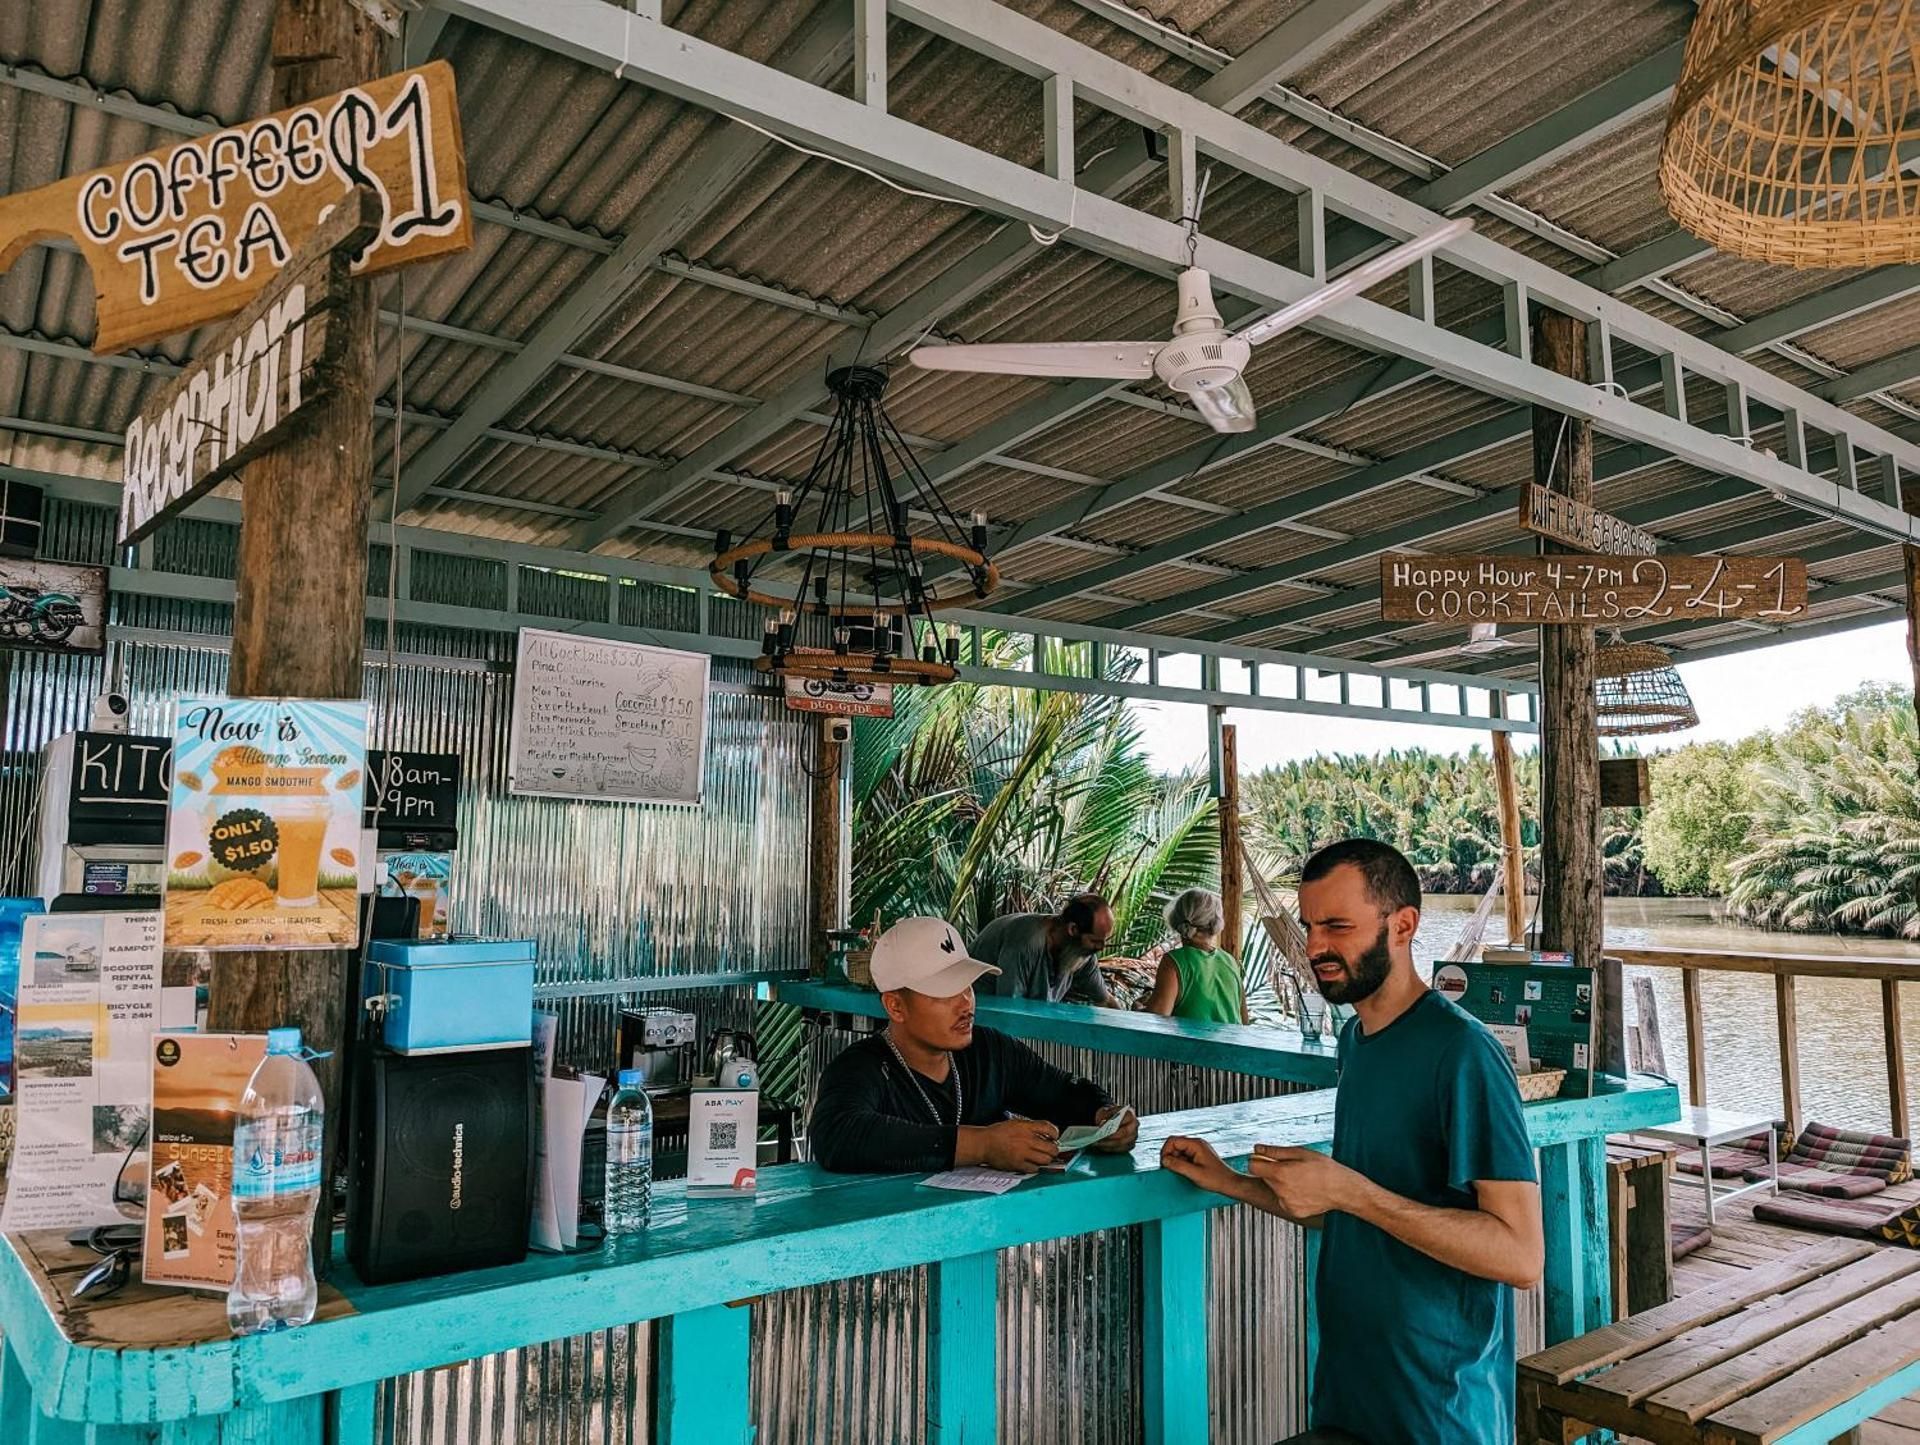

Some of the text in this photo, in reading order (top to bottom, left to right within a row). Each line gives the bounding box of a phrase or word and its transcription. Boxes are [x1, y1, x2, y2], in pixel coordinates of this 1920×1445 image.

[80, 75, 461, 266] COFFEE $1
[121, 203, 290, 304] TEA
[1393, 563, 1470, 587] Happy
[1479, 563, 1536, 587] Hour
[1624, 559, 1803, 618] 2-4-1
[1416, 591, 1620, 618] COCKTAILS
[810, 701, 873, 714] DUO GLIDE
[186, 706, 301, 742] Now is
[296, 746, 347, 766] Season
[226, 775, 261, 787] MANGO
[215, 819, 262, 840] ONLY
[224, 839, 274, 862] $1.50
[201, 918, 228, 926] FRESH
[103, 964, 154, 972] SCOOTER
[169, 1142, 223, 1162] Sunset
[451, 1123, 463, 1198] audio-technica
[216, 1229, 236, 1242] Every
